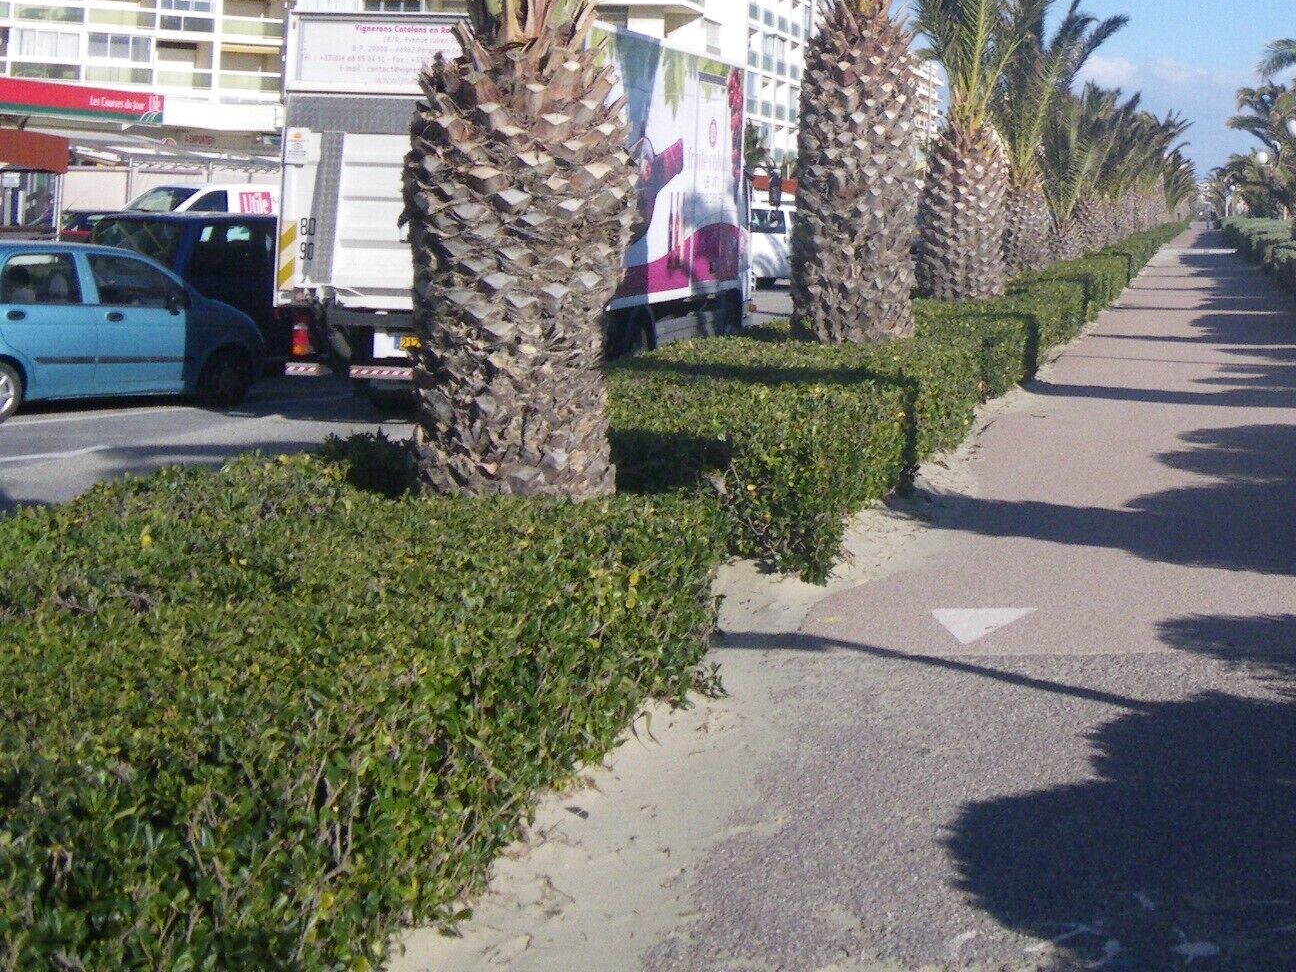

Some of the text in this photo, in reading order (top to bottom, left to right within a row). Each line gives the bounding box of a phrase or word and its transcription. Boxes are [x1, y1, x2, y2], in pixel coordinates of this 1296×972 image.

[355, 25, 392, 34] Vignerons
[242, 192, 271, 215] Utile
[300, 242, 315, 260] 90
